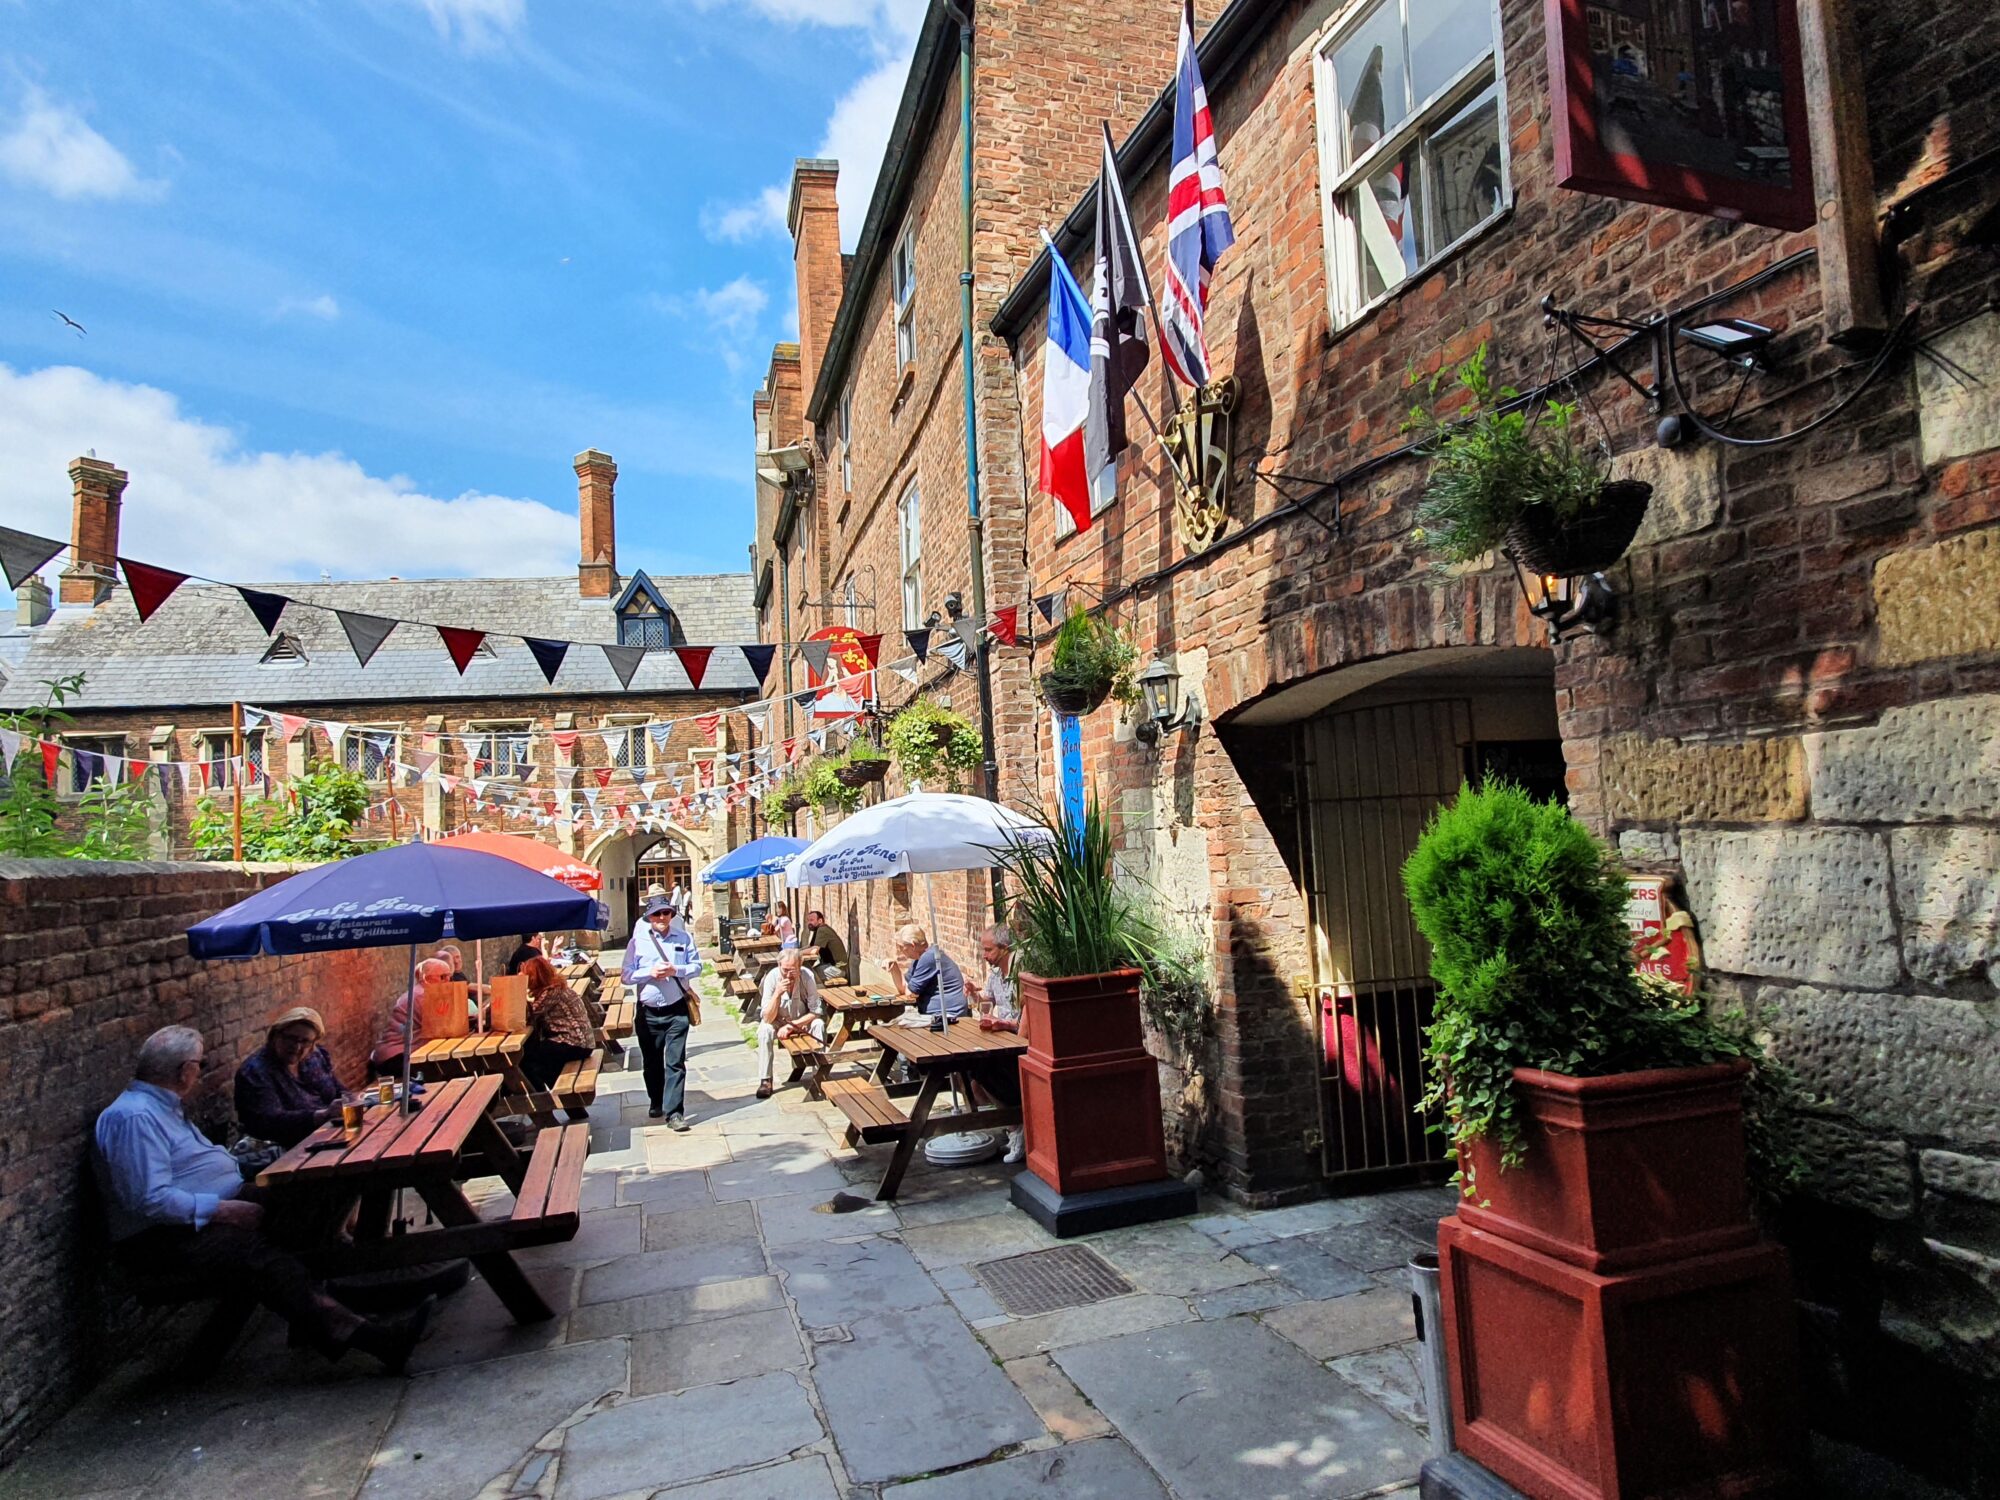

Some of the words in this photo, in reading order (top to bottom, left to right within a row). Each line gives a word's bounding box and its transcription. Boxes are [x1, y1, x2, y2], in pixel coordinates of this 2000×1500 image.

[1062, 736, 1081, 758] Ren
[809, 847, 855, 869] Café
[857, 843, 898, 862] René
[823, 874, 843, 882] Steak
[850, 869, 885, 880] Grillhouse
[838, 863, 873, 874] Restaurant
[1629, 888, 1657, 901] ERS
[276, 901, 360, 925] Café
[364, 896, 439, 917] René
[328, 918, 393, 931] Restaurant
[301, 932, 335, 943] Steak
[351, 928, 410, 940] Grillhouse
